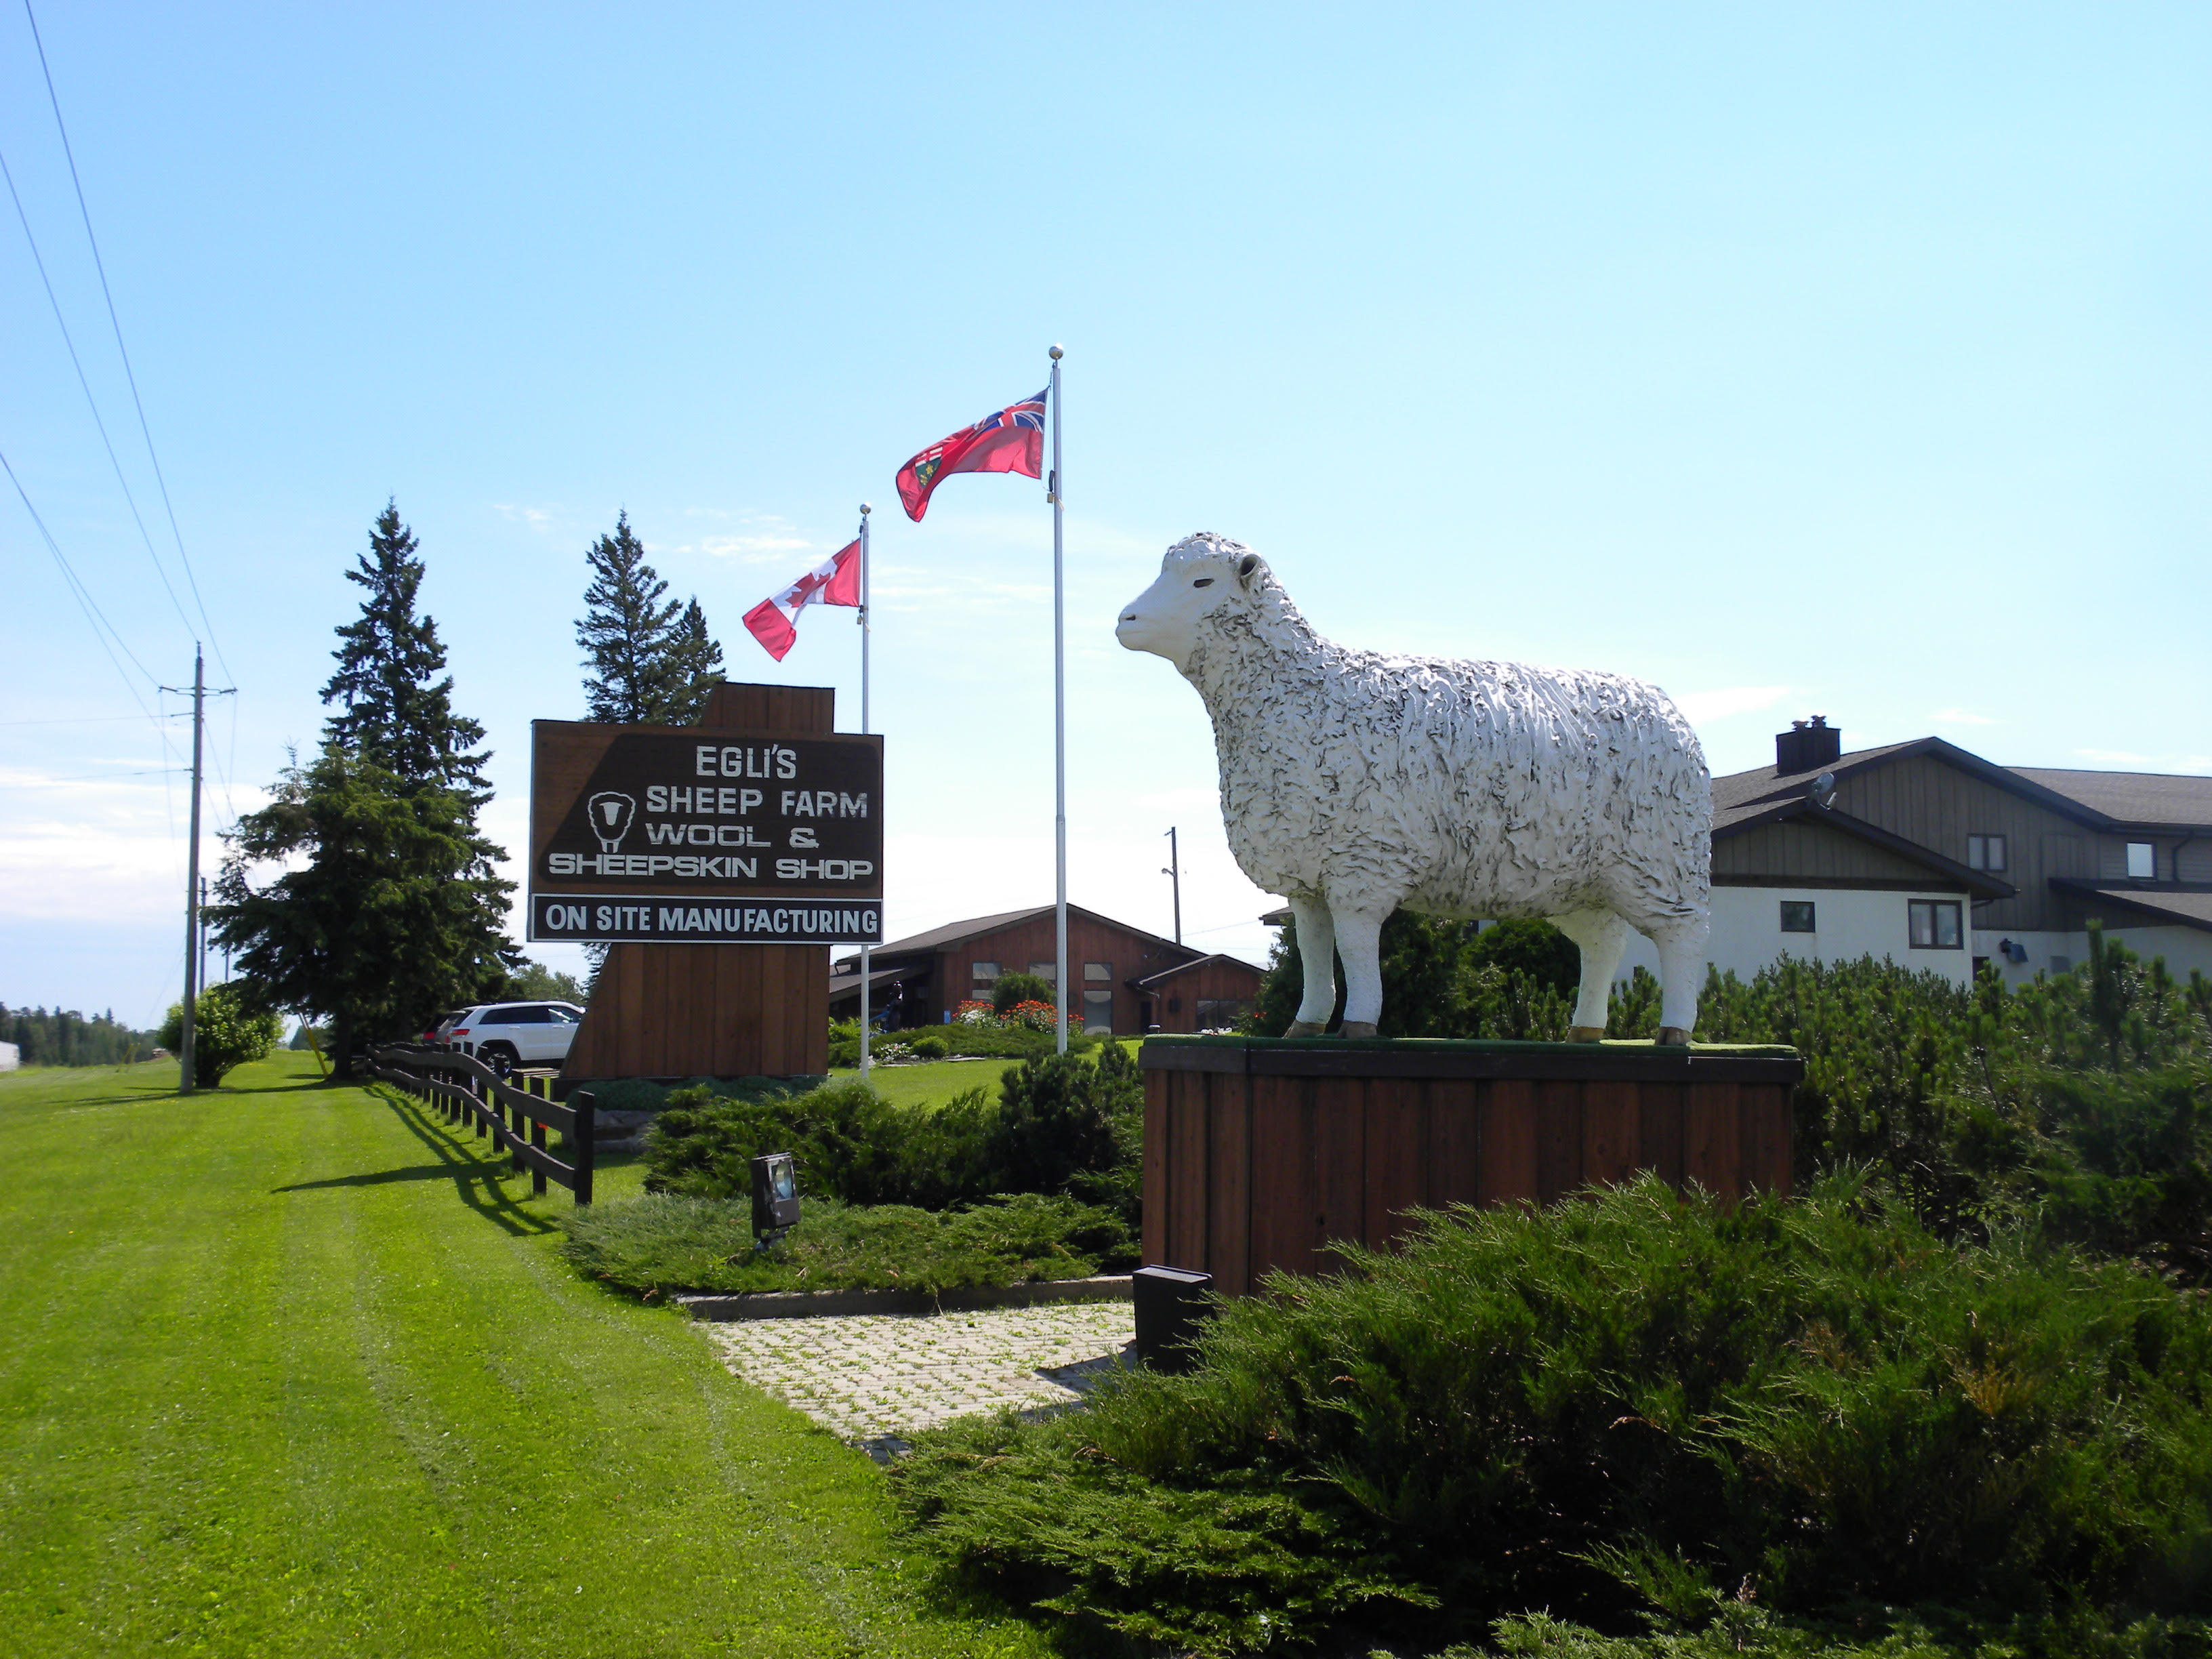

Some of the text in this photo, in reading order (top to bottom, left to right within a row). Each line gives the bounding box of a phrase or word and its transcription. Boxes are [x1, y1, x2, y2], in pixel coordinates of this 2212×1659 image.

[696, 743, 797, 779] EGLI'S
[646, 785, 867, 818] SHEEP FARM
[645, 823, 819, 848] WOOL &
[548, 853, 874, 880] SHEEPSKIN SHOP
[546, 904, 878, 934] ON SITE MANUFACTURING
